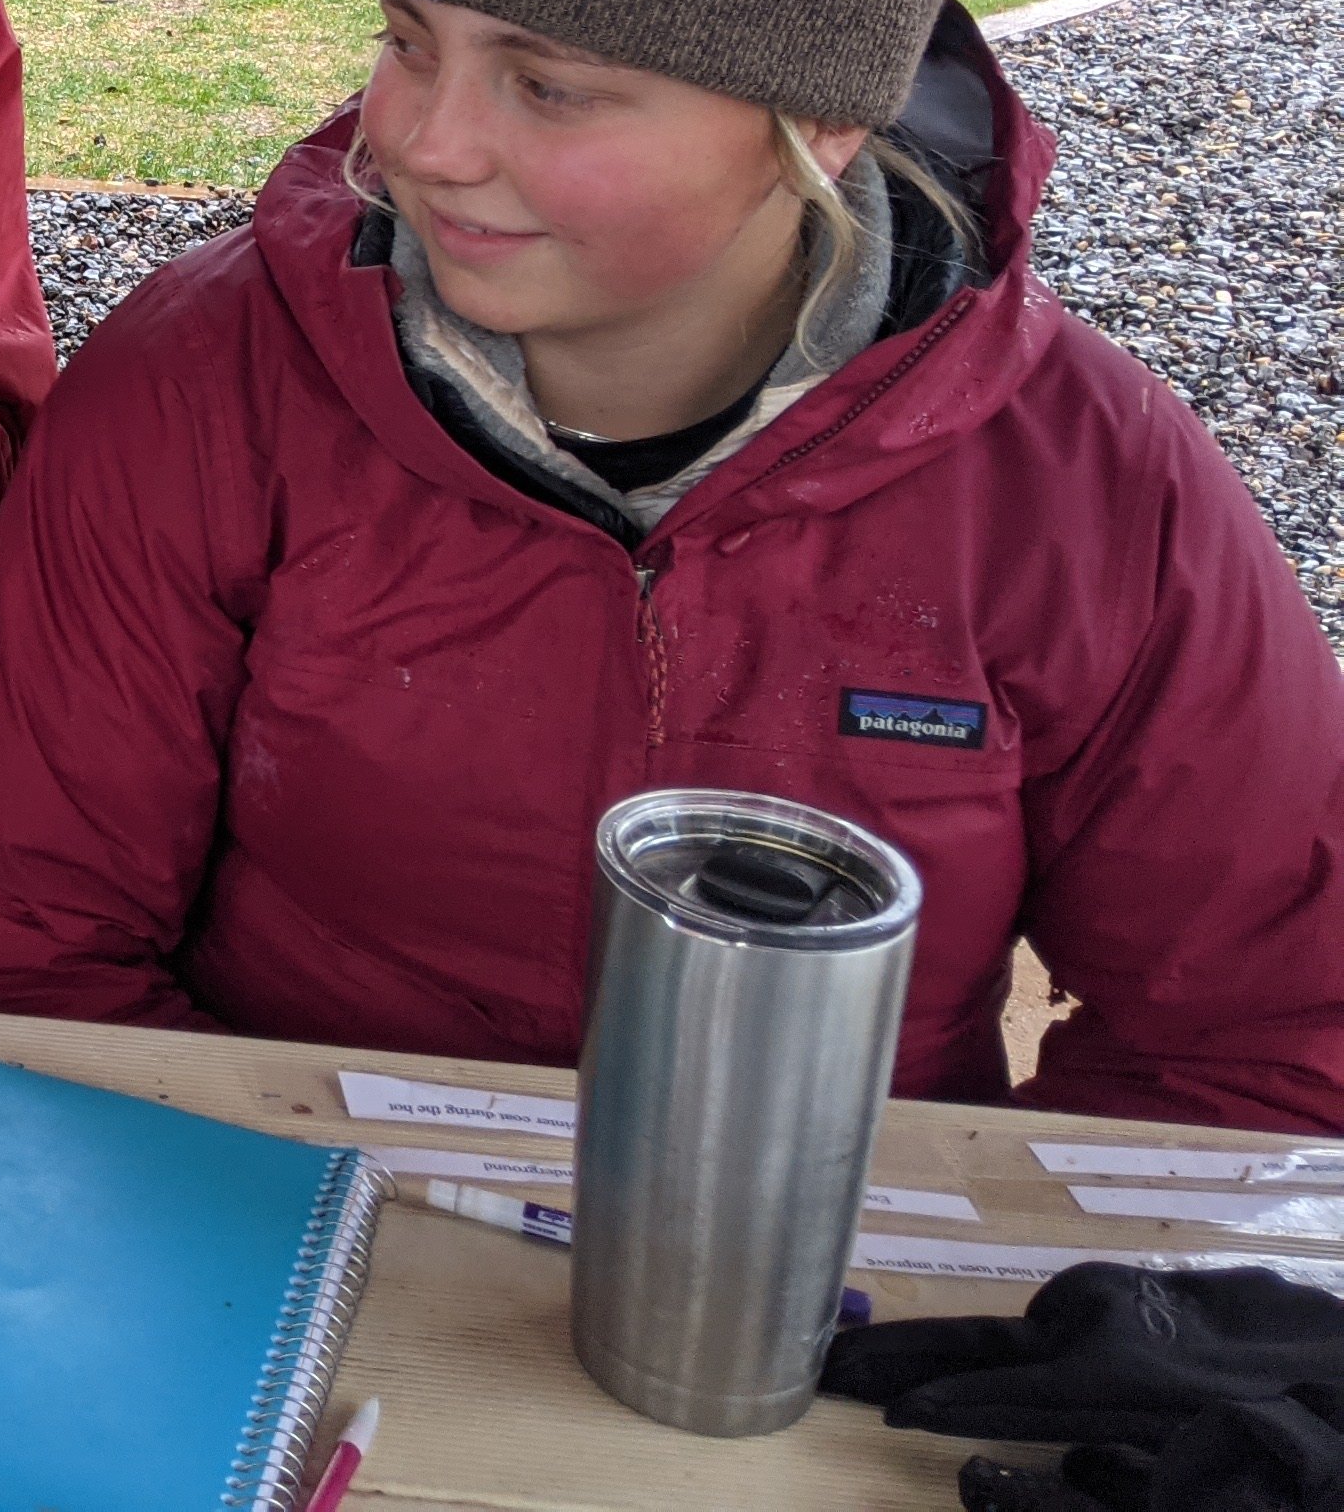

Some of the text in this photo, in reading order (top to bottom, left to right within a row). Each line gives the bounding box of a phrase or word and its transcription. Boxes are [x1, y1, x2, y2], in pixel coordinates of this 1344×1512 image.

[859, 714, 968, 740] patagonia
[388, 1102, 414, 1114] hot
[417, 1102, 443, 1115] the
[445, 1104, 495, 1120] during
[498, 1111, 531, 1123] coat
[483, 1161, 573, 1178] nderground
[866, 1258, 936, 1273] improve
[937, 1263, 955, 1273] to
[958, 1264, 993, 1275] toes
[995, 1266, 1035, 1279] hind
